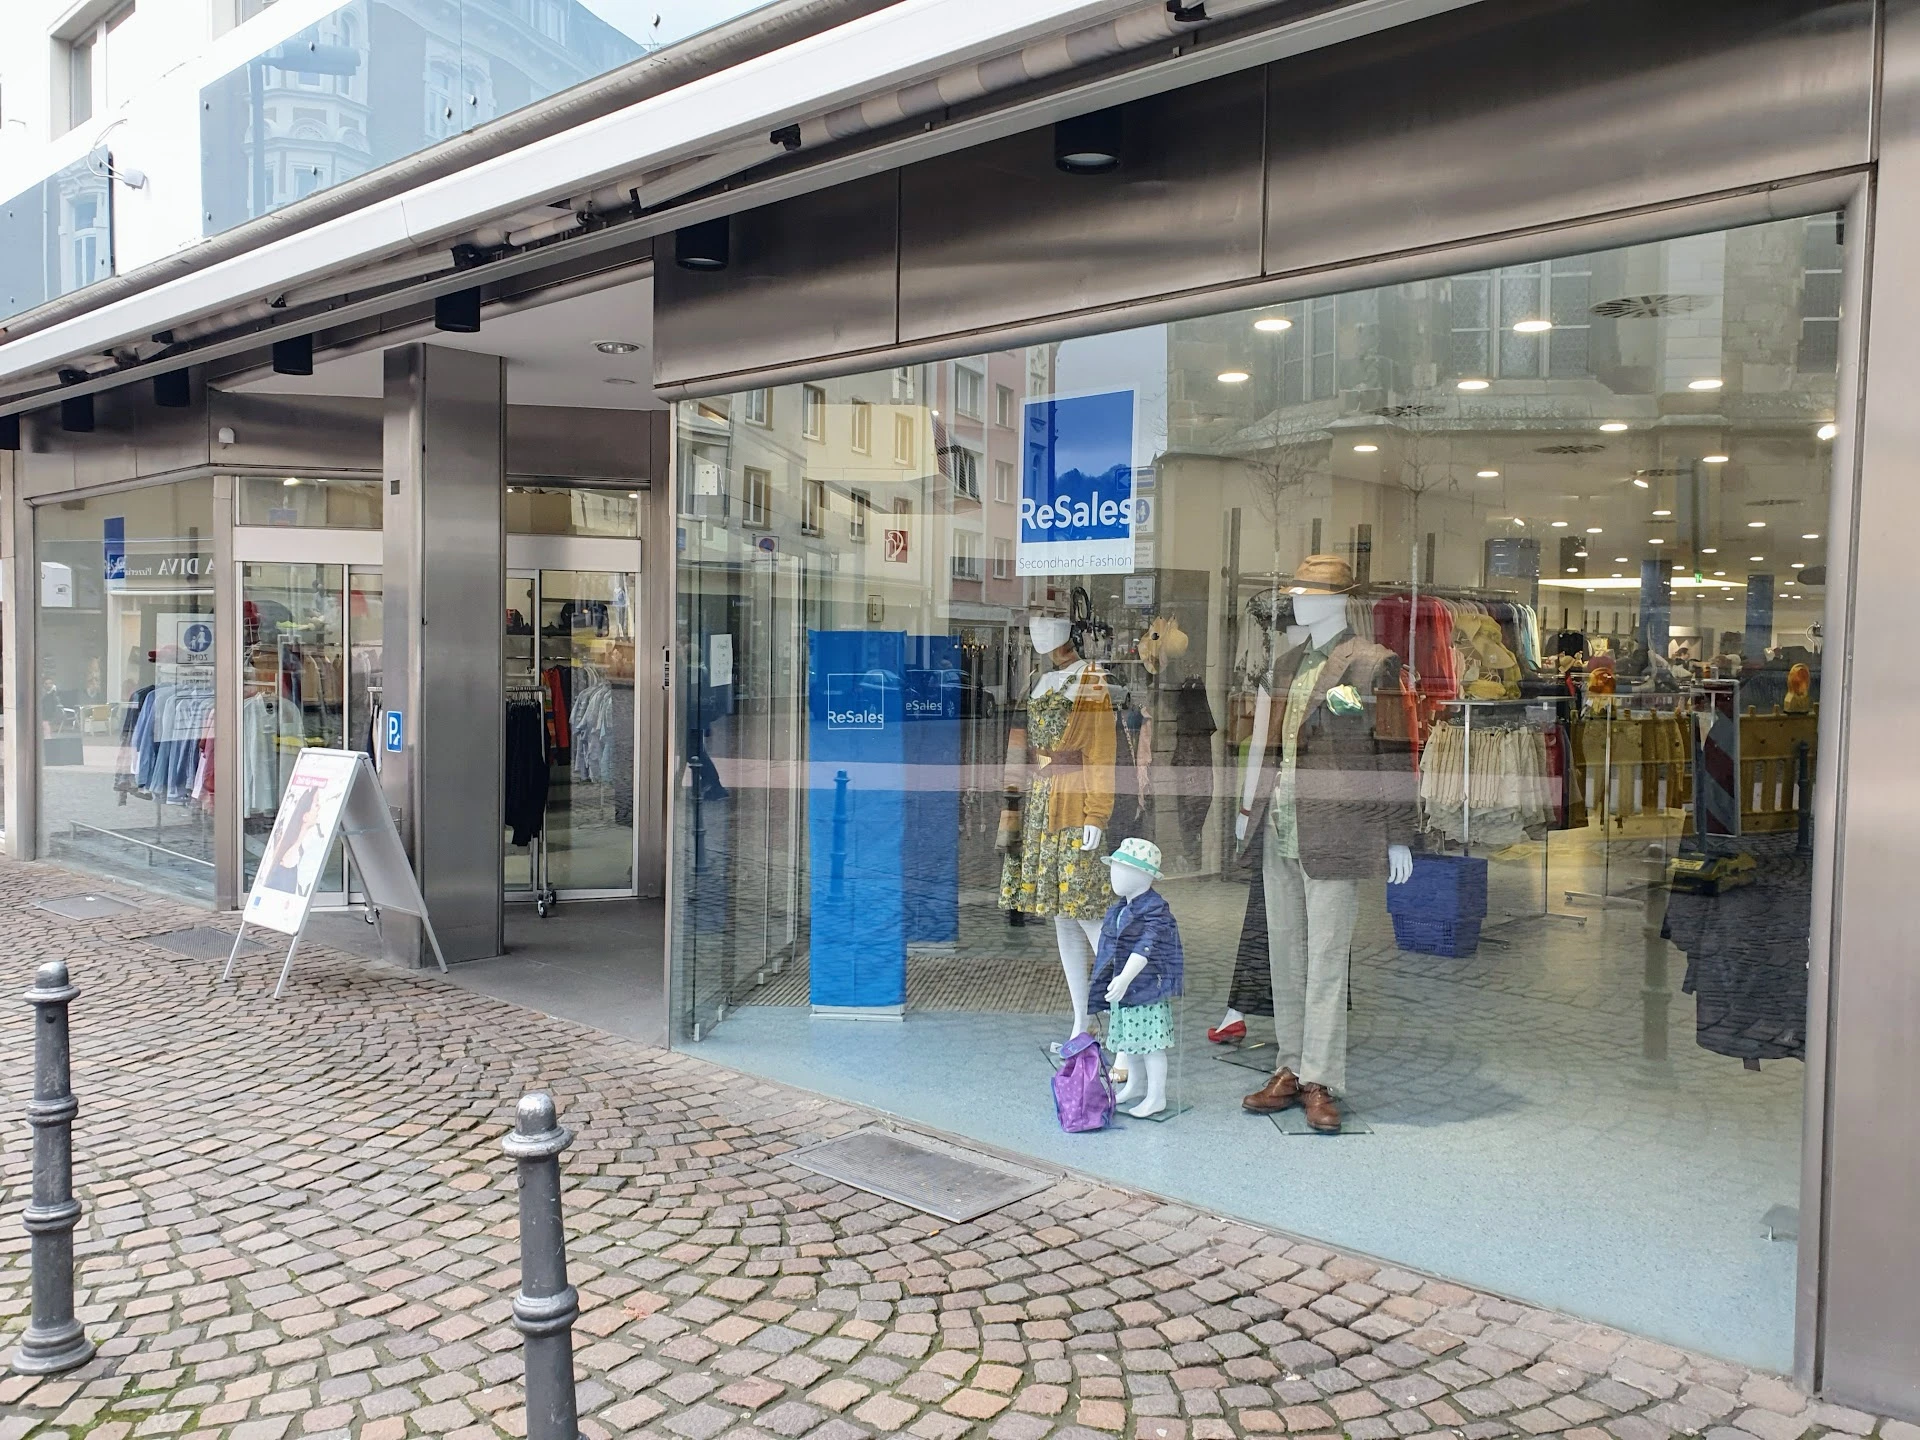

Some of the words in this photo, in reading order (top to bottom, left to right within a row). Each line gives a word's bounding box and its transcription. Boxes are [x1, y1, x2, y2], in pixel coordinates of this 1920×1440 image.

[1020, 491, 1132, 530] ReSales
[1018, 554, 1132, 570] Secondhand-Fashion
[905, 699, 942, 712] eSales
[828, 710, 883, 724] ReSales
[389, 716, 399, 745] P
